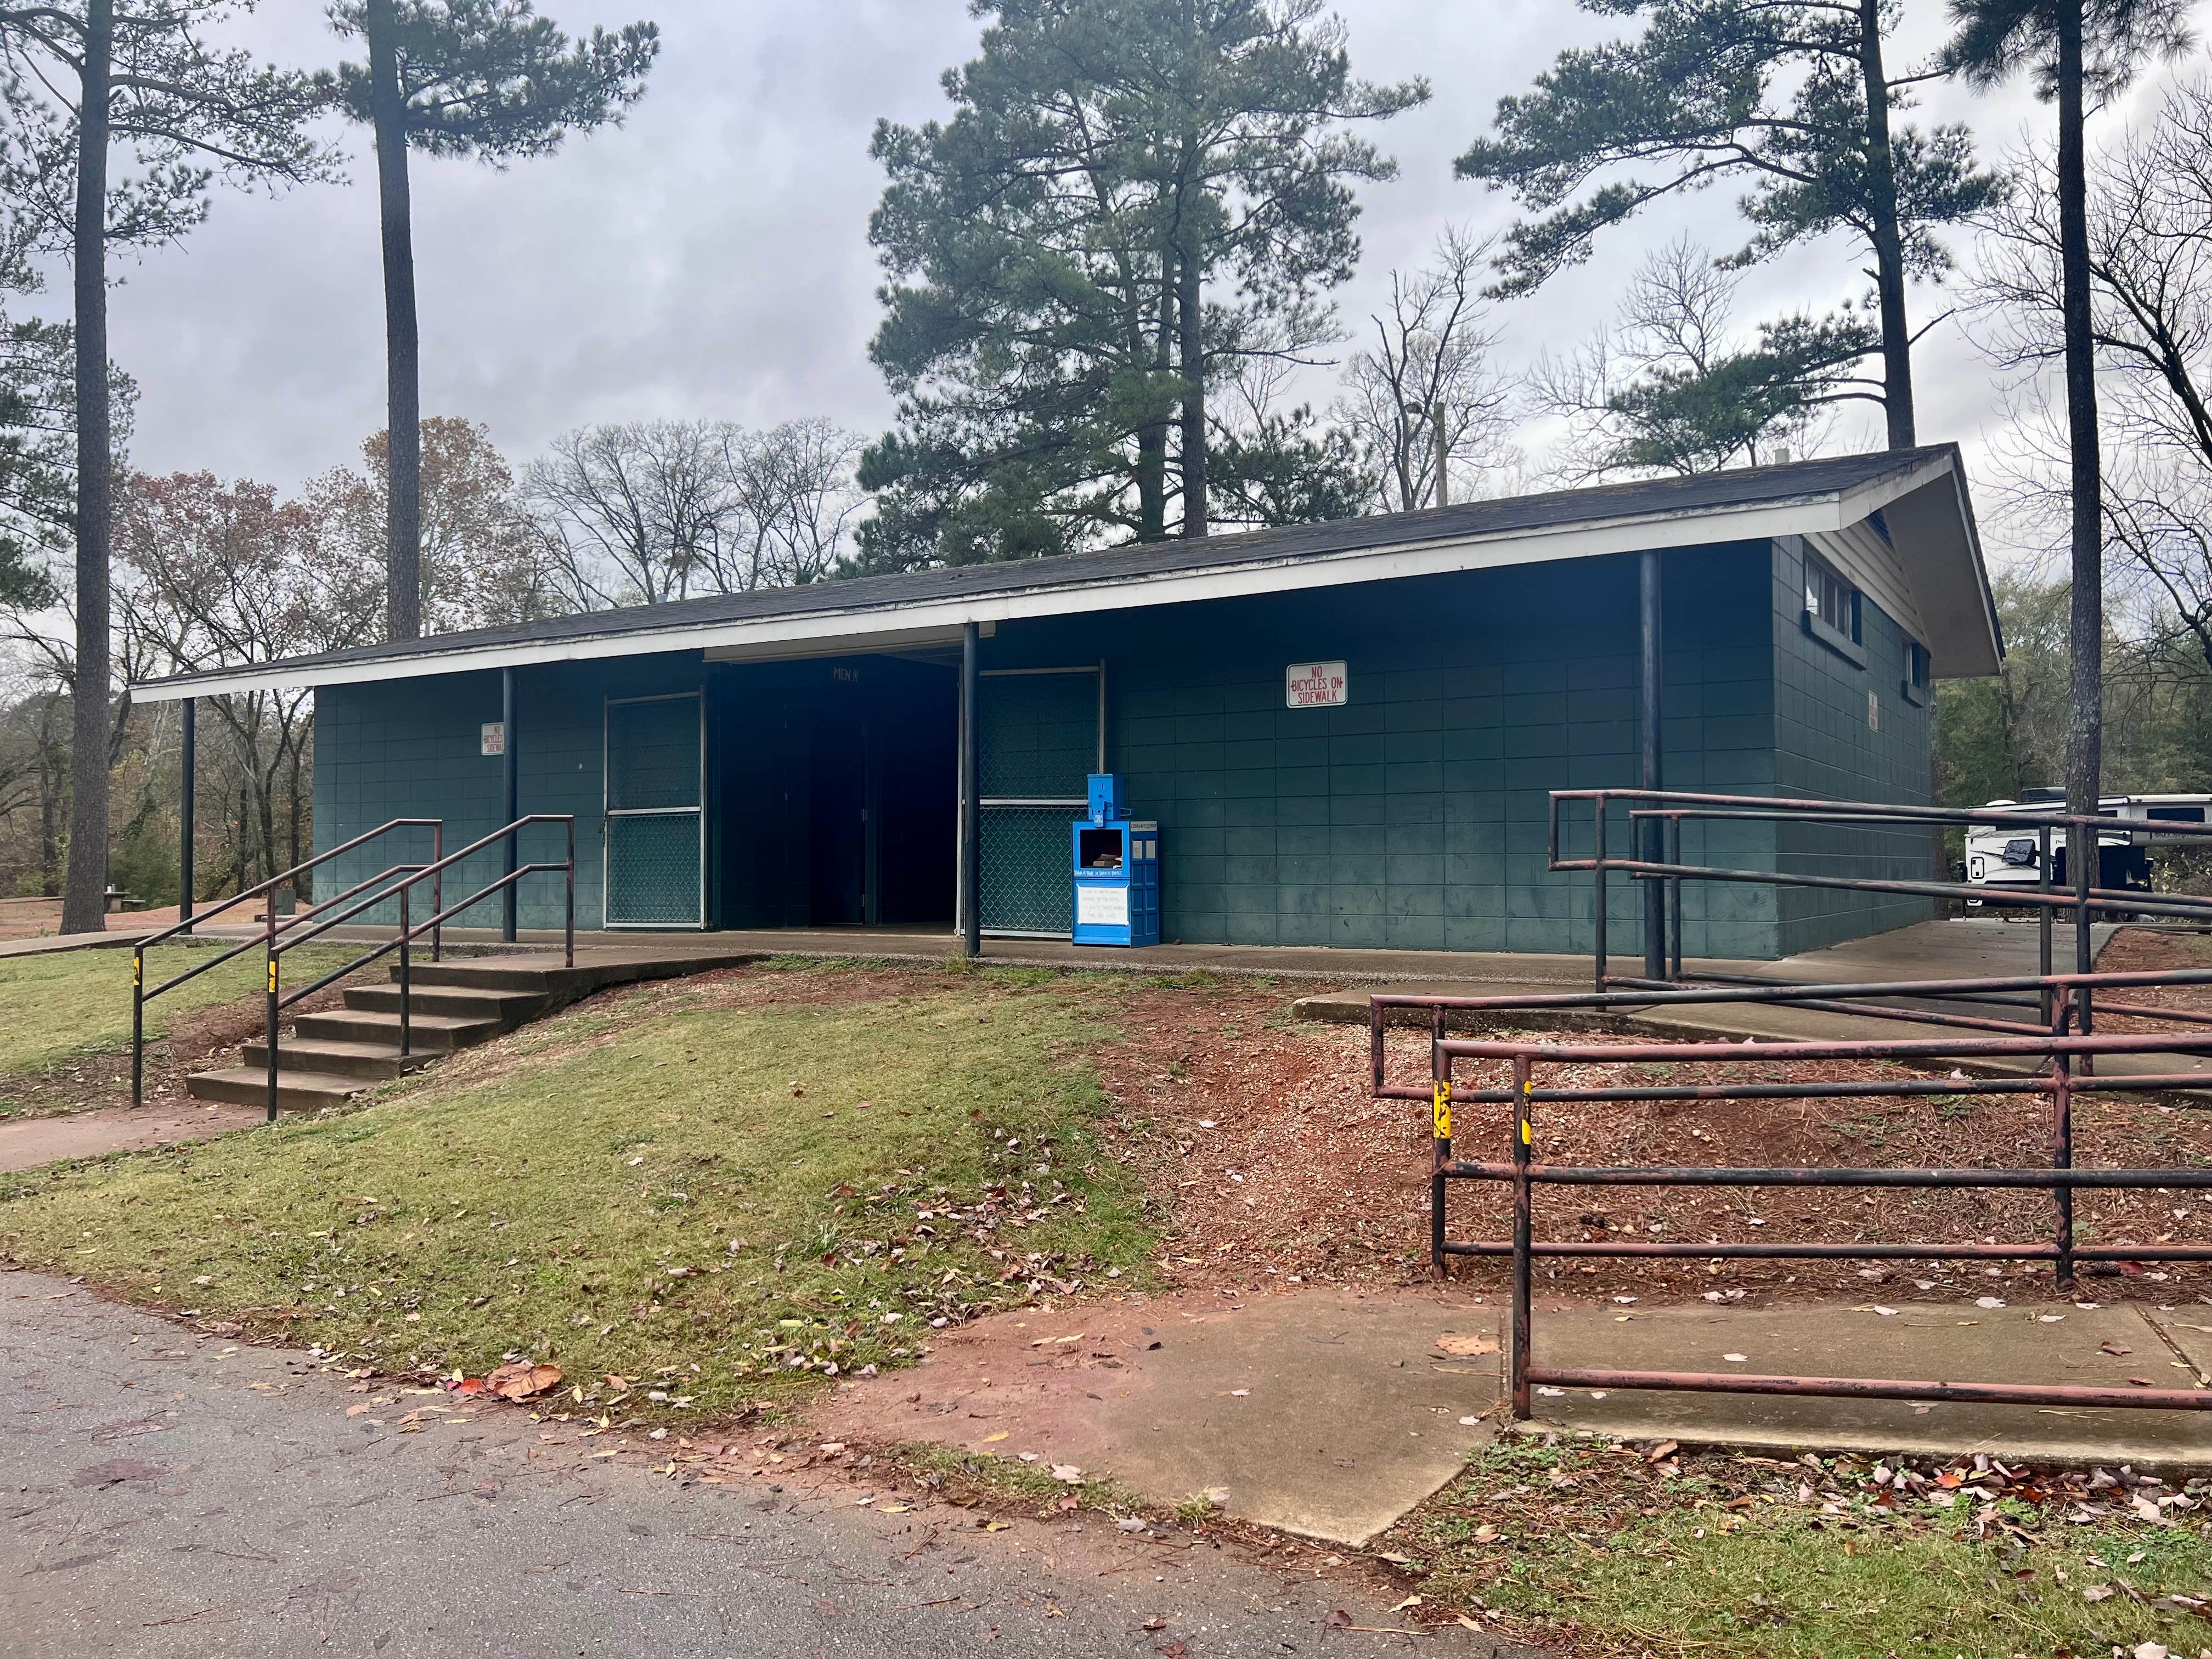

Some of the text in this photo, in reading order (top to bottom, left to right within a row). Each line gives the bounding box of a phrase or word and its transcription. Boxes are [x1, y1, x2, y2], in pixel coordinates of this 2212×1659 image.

[833, 667, 851, 681] MEN
[1311, 665, 1323, 678] NO
[1291, 676, 1342, 692] BICYCLES ON
[1297, 690, 1337, 704] SIDEWALK
